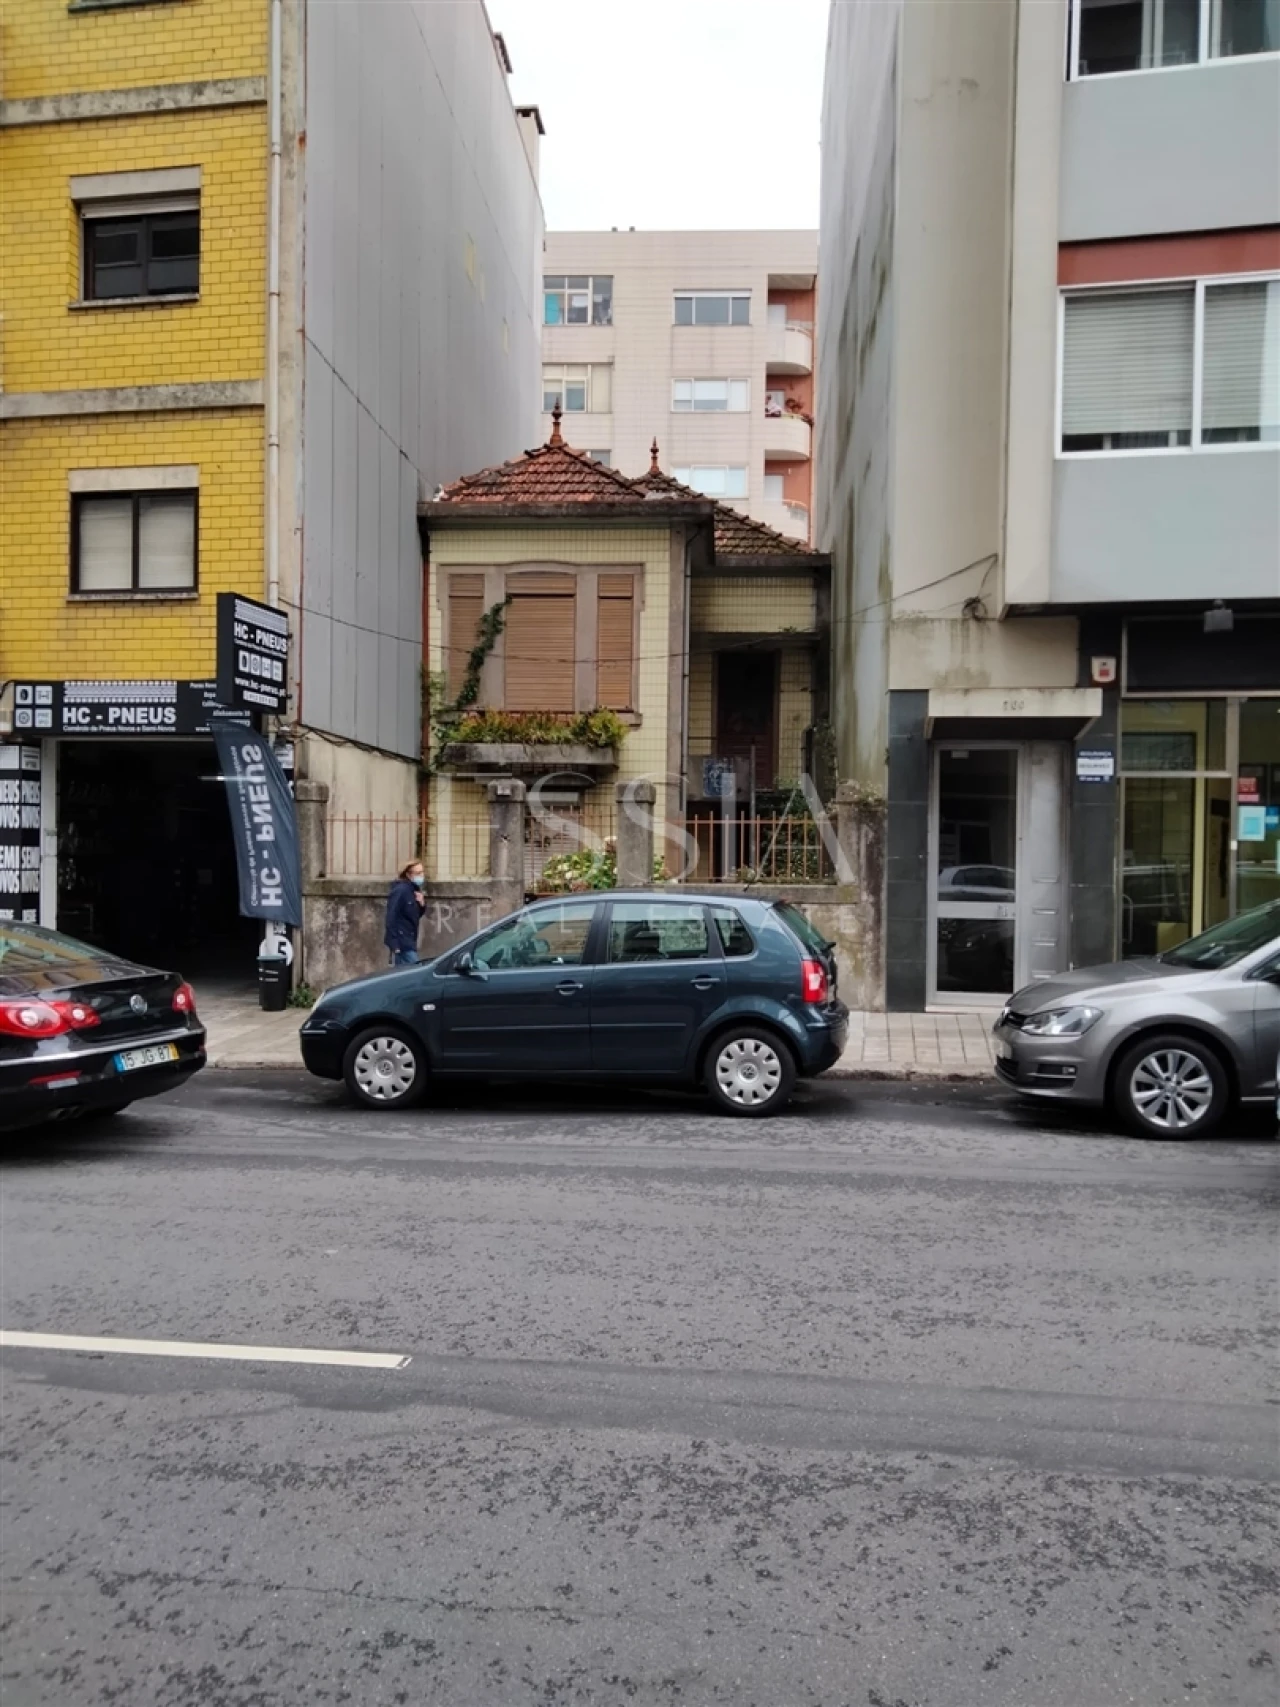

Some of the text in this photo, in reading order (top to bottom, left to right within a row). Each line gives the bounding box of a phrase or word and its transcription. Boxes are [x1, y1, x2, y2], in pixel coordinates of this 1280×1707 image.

[234, 622, 248, 640] HC
[255, 629, 287, 652] PNEUS
[62, 707, 91, 724] HC
[108, 707, 177, 724] PNEUS
[0, 779, 20, 803] NEUS
[0, 845, 20, 868] EMI
